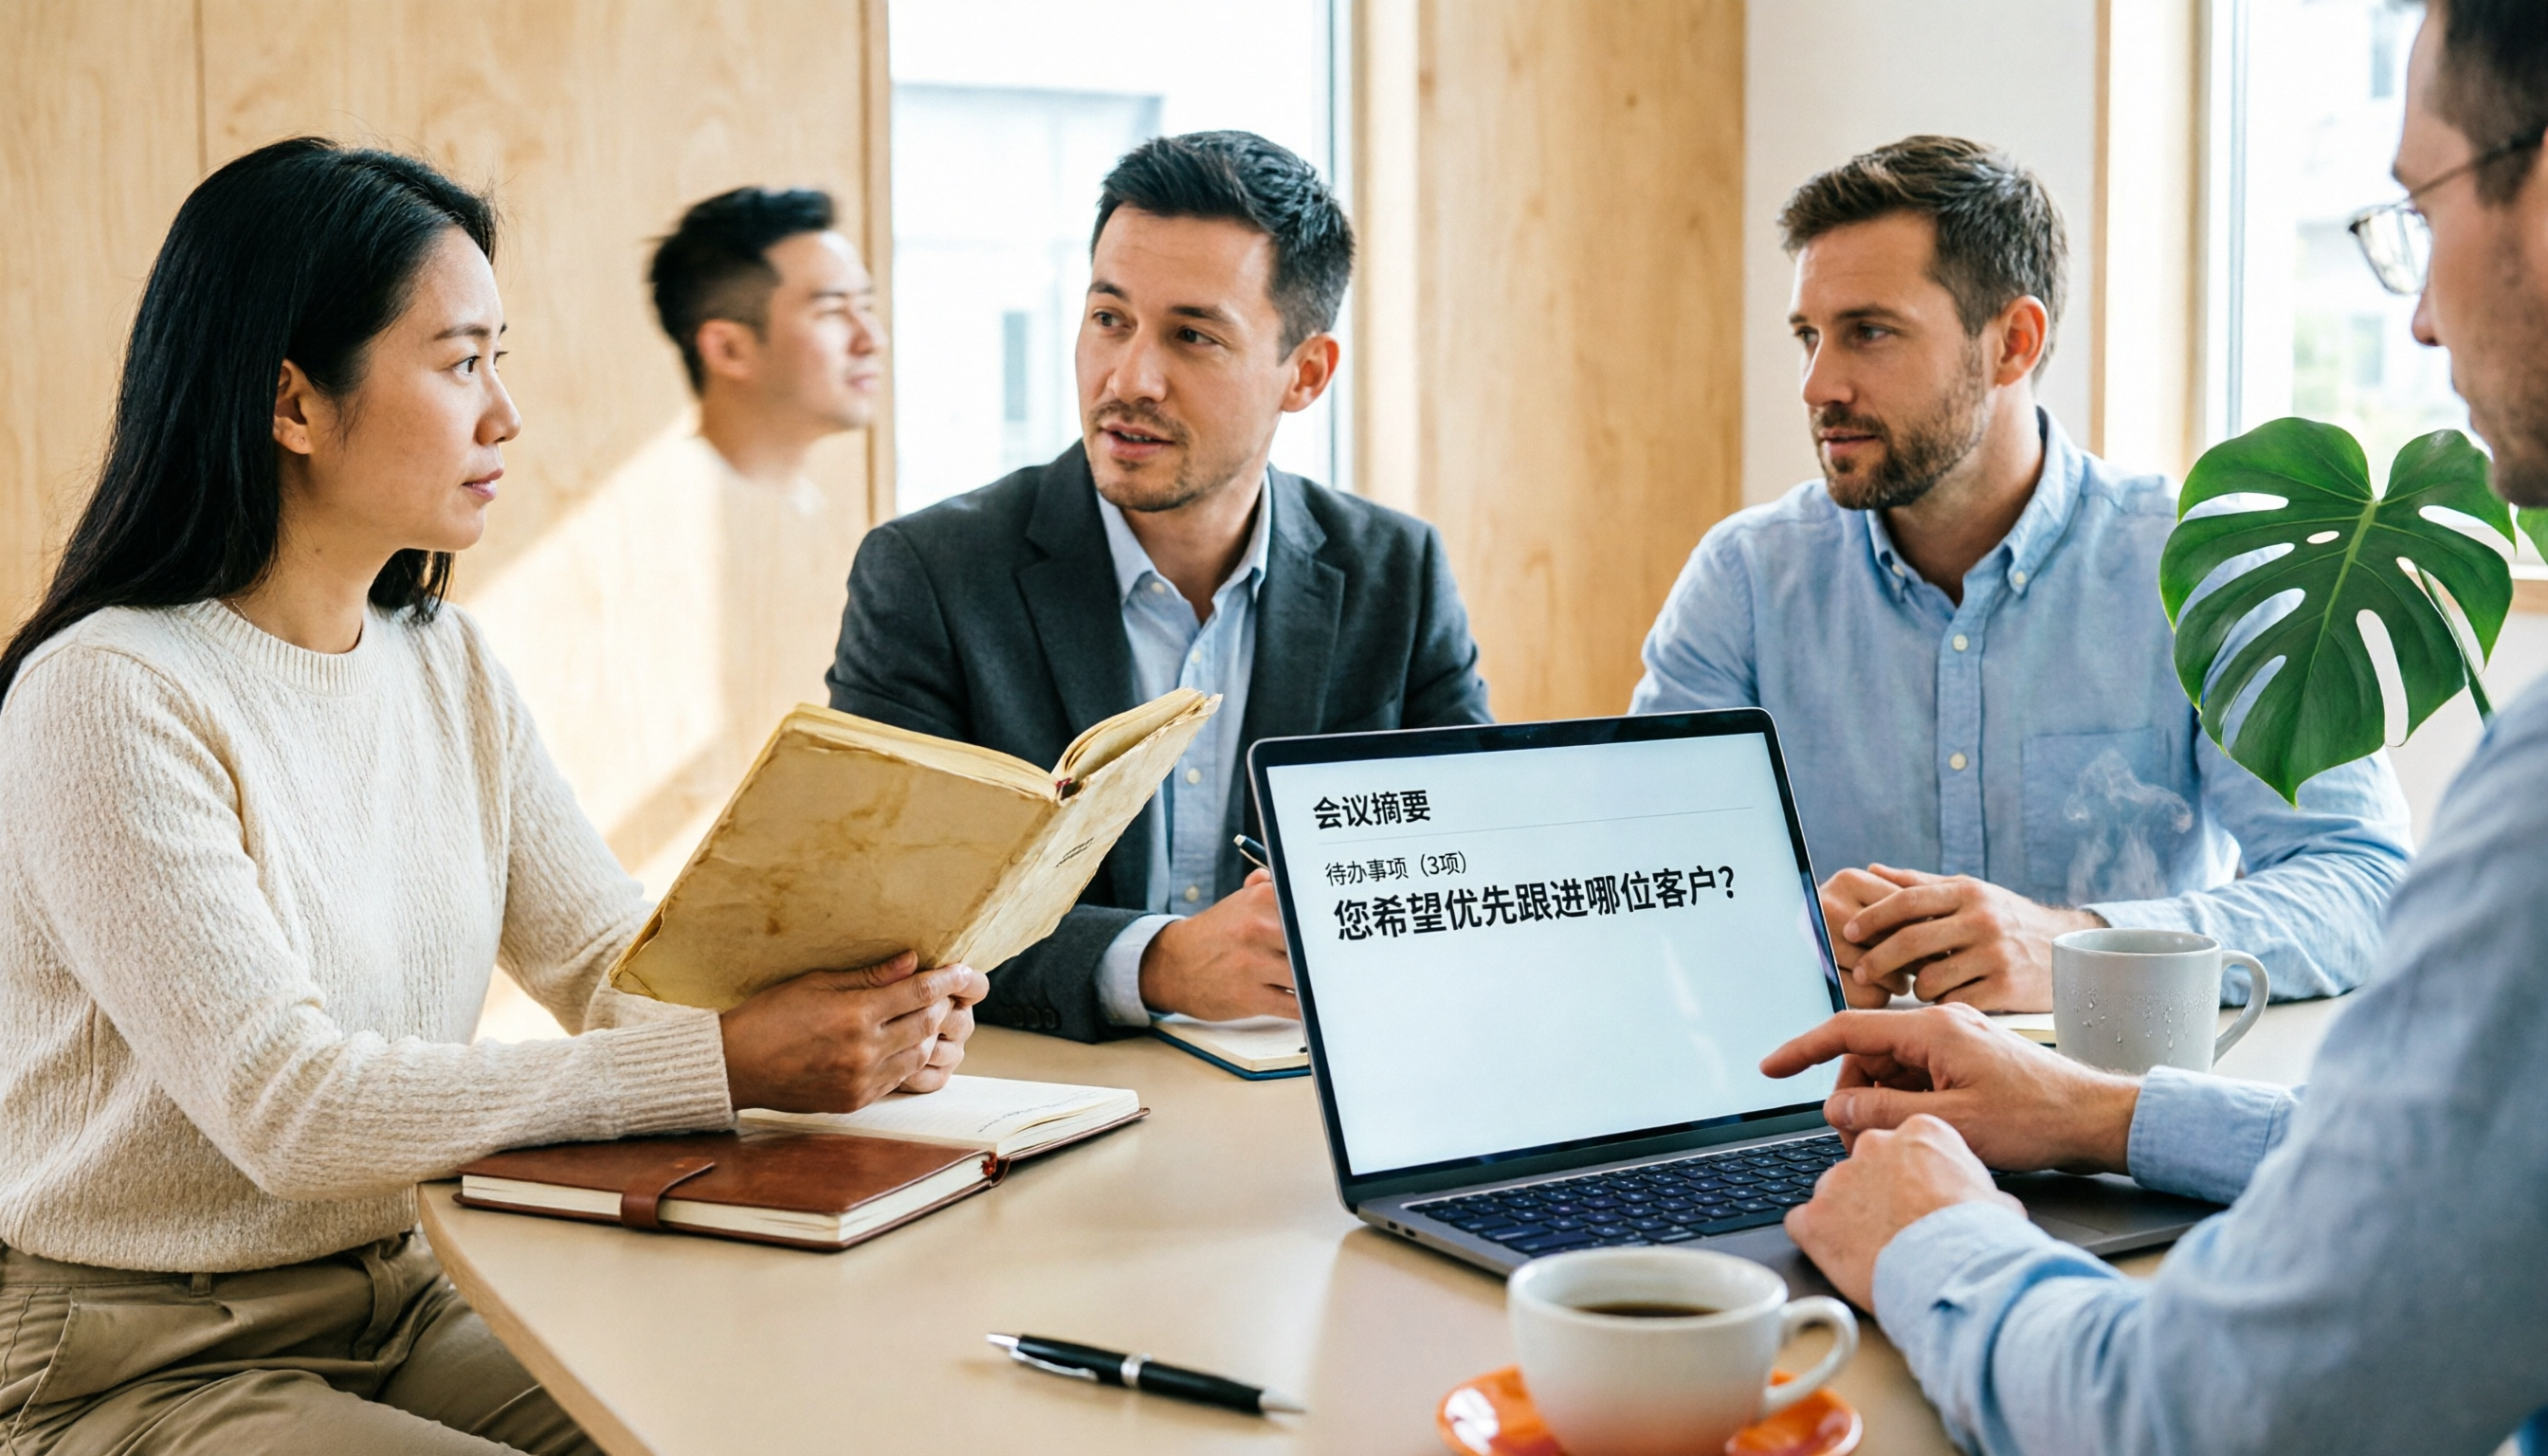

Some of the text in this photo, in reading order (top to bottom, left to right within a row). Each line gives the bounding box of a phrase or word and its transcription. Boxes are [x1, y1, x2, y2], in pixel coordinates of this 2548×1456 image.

[1313, 790, 1431, 830] 会议摘要
[1333, 864, 1735, 941] 您希望优先跟进哪位客户?
